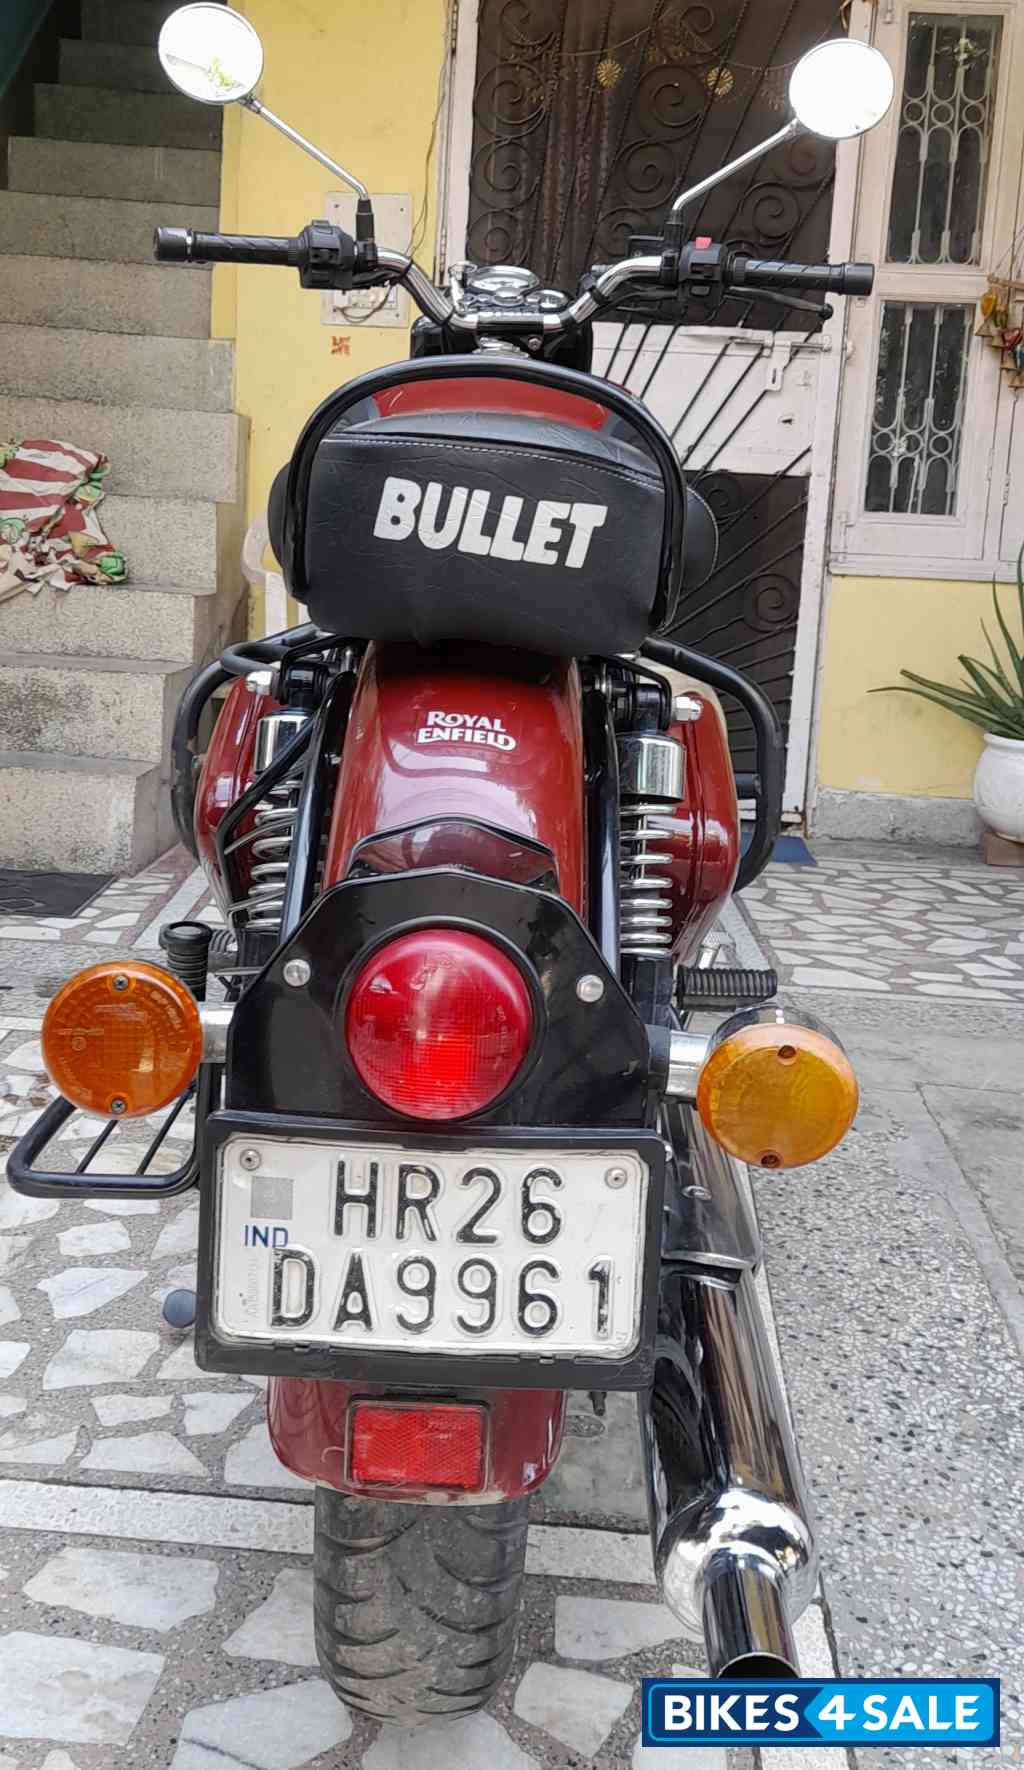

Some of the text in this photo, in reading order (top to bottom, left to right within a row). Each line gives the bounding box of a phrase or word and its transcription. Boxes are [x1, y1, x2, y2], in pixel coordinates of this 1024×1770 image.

[373, 476, 608, 568] BULLET
[416, 728, 517, 751] ENFIELD
[427, 711, 507, 732] ROYAL
[333, 1160, 564, 1245] HR26
[245, 1224, 288, 1248] IND
[270, 1252, 611, 1337] DA9961
